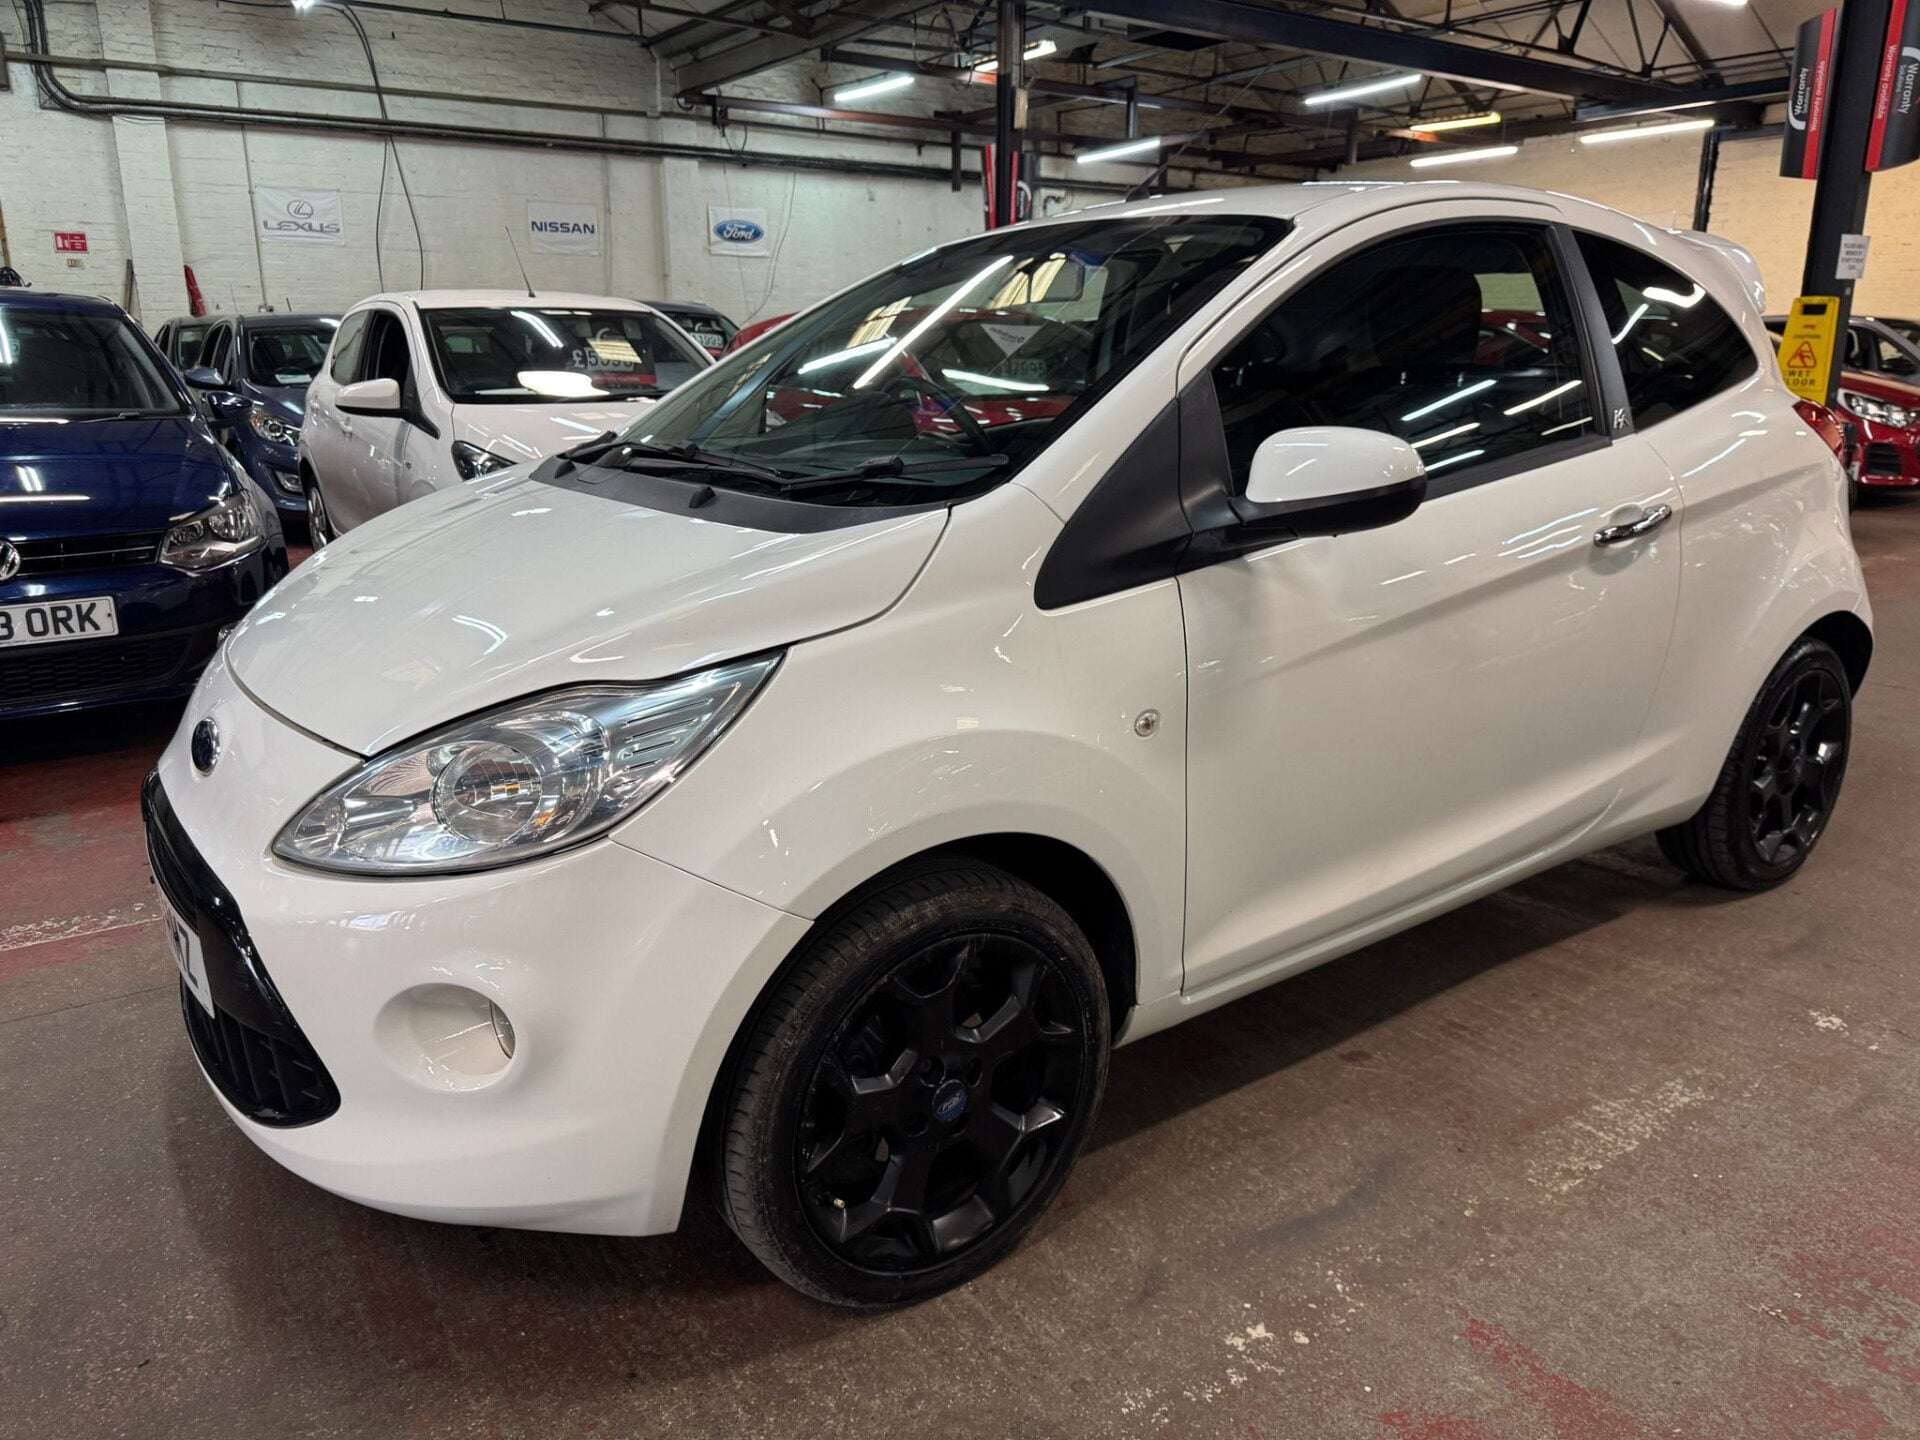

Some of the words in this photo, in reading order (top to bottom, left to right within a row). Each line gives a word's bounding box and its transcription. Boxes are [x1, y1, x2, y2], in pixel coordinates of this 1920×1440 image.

[1882, 45, 1897, 82] Warranty
[1793, 67, 1809, 116] Warranty
[1897, 62, 1919, 115] Warranty
[1810, 96, 1822, 132] Warranty
[263, 220, 340, 233] LEXUS
[531, 221, 595, 234] NISSAN
[723, 224, 755, 239] Ford
[1783, 378, 1816, 387] LOOR
[25, 602, 101, 637] ORK
